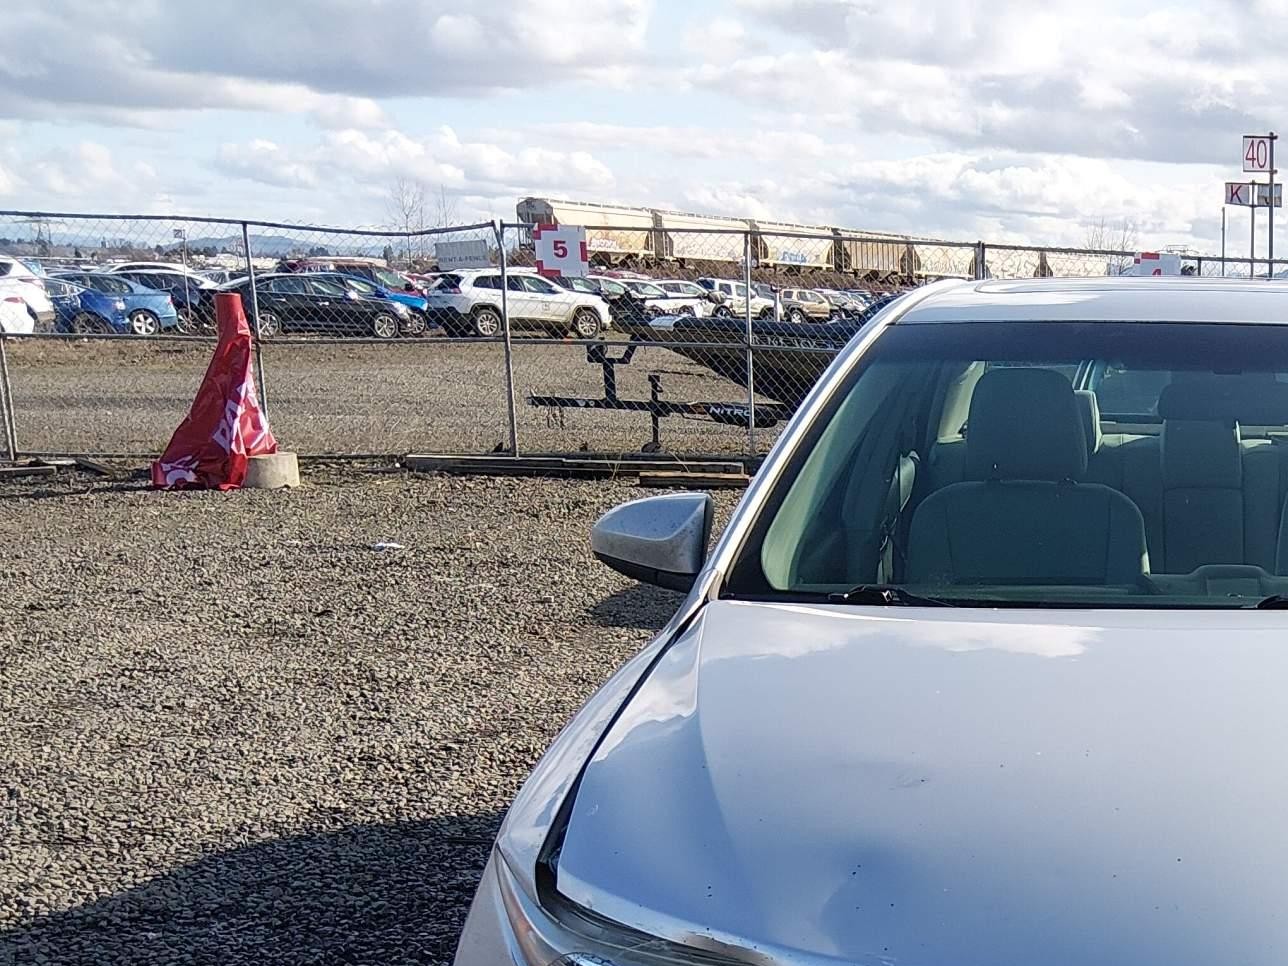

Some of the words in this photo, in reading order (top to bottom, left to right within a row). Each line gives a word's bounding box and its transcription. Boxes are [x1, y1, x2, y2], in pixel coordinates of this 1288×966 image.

[1245, 139, 1267, 169] 40
[1230, 184, 1242, 204] K
[553, 240, 568, 258] 5
